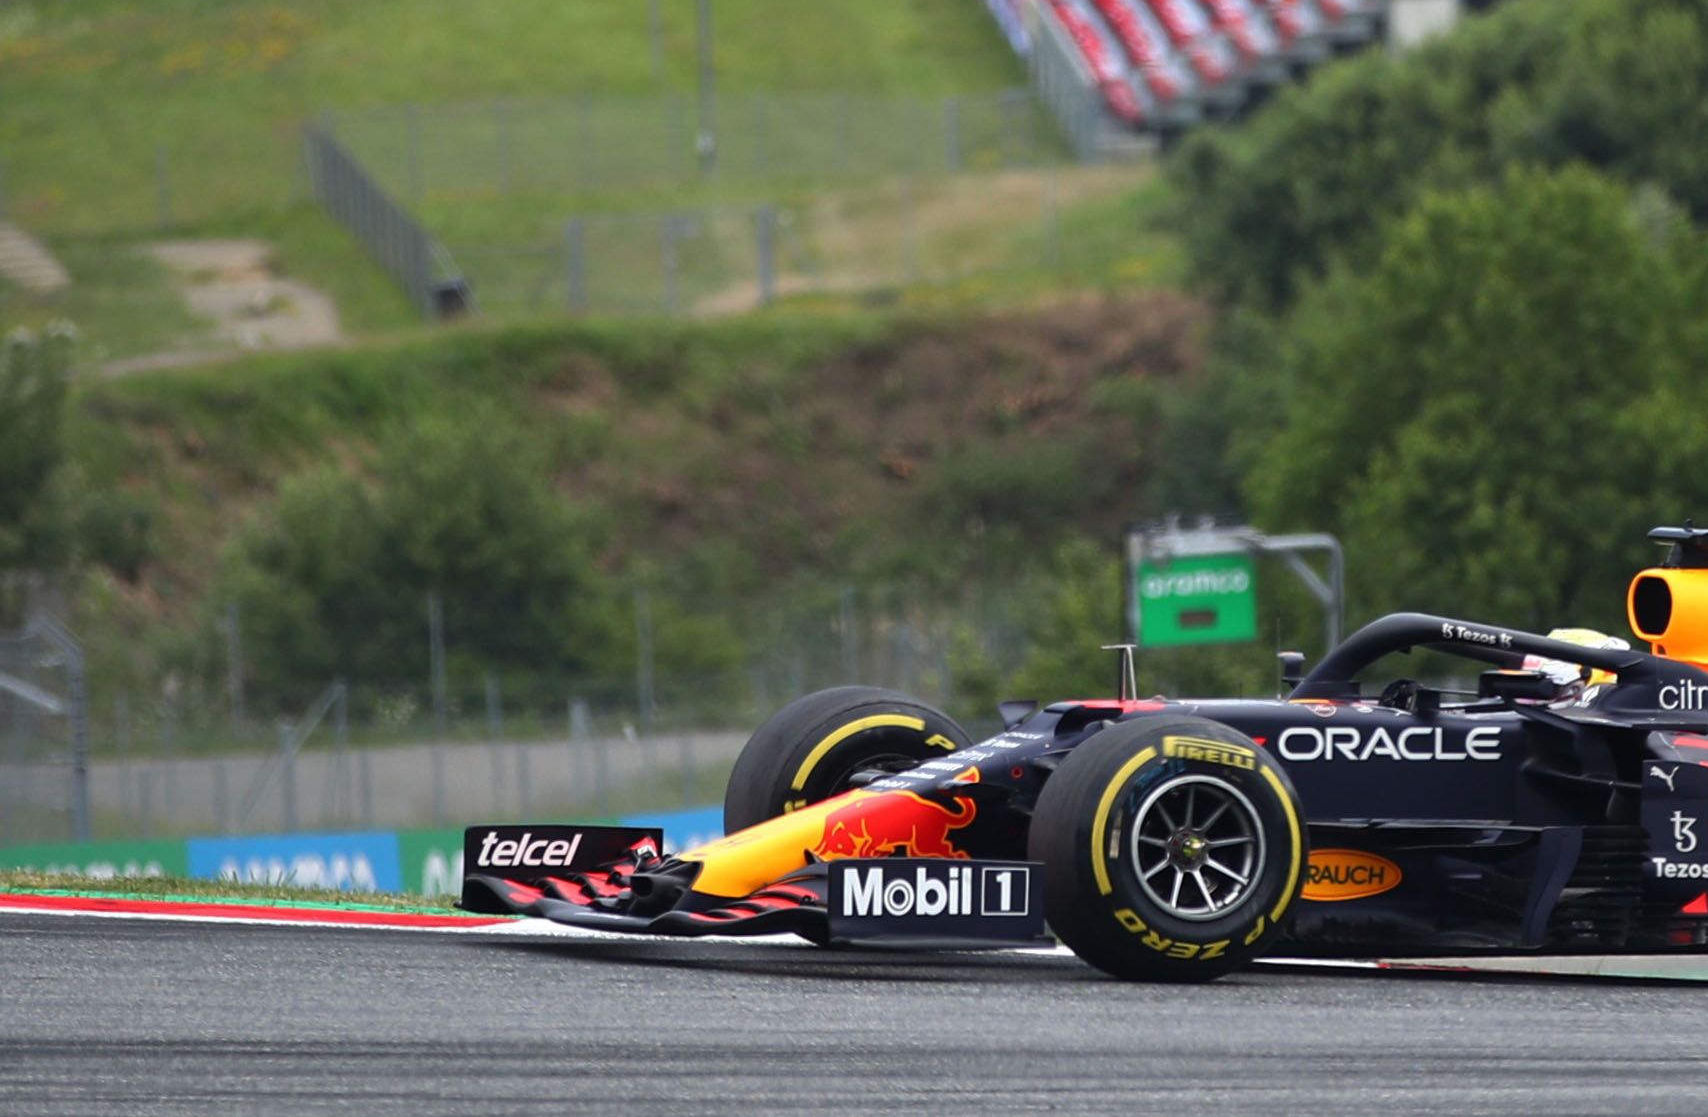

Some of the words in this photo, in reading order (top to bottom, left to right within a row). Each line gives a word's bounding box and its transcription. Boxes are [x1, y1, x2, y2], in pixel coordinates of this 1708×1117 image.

[1456, 626, 1496, 645] Tezos
[1162, 735, 1256, 770] PIRELLI
[1278, 727, 1502, 761] ORACLE
[477, 832, 582, 867] telcel
[843, 867, 972, 916] Mobil
[1306, 864, 1385, 886] RAUCH
[1114, 908, 1231, 960] ZERO
